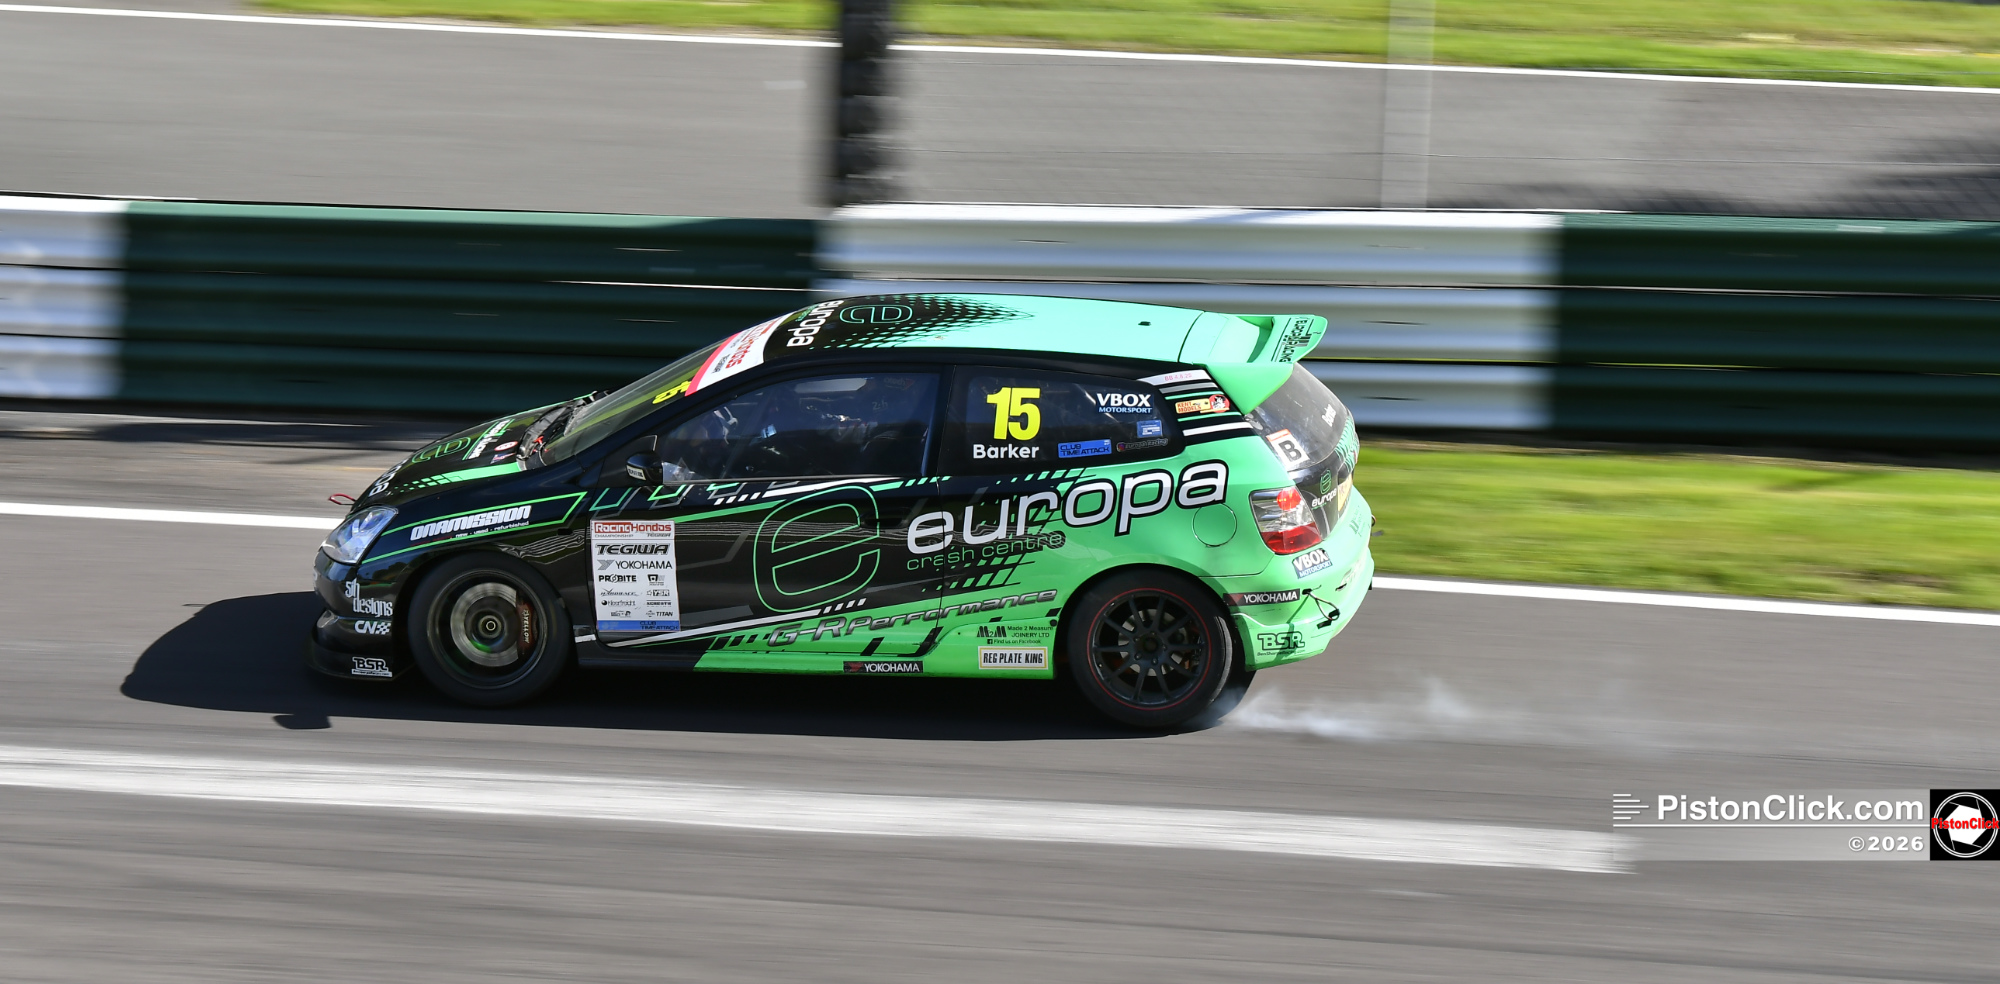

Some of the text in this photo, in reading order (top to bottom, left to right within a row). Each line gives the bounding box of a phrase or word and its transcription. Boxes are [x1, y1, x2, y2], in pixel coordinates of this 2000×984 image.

[787, 300, 844, 347] europa
[1096, 393, 1151, 407] VBOX
[986, 387, 1041, 440] 15
[1098, 406, 1152, 414] MOTORSPORT
[972, 444, 1040, 459] Barker
[1081, 446, 1110, 455] ATTACK
[1278, 440, 1302, 462] B
[907, 461, 1229, 554] europa
[596, 544, 670, 555] TEGIWA
[906, 533, 1062, 570] crash centre
[615, 560, 672, 570] YOKOHAMA
[1293, 549, 1328, 571] VBOX
[1298, 561, 1331, 577] MOTORSPORT
[599, 574, 637, 583] PROBITE
[1244, 591, 1297, 602] YOKOHAMA
[353, 598, 393, 617] designs
[354, 620, 377, 634] CN
[1257, 631, 1305, 651] BSR
[352, 656, 389, 672] BSR
[983, 653, 1043, 663] REG PLATE KING
[864, 663, 919, 672] YOKOHAMA
